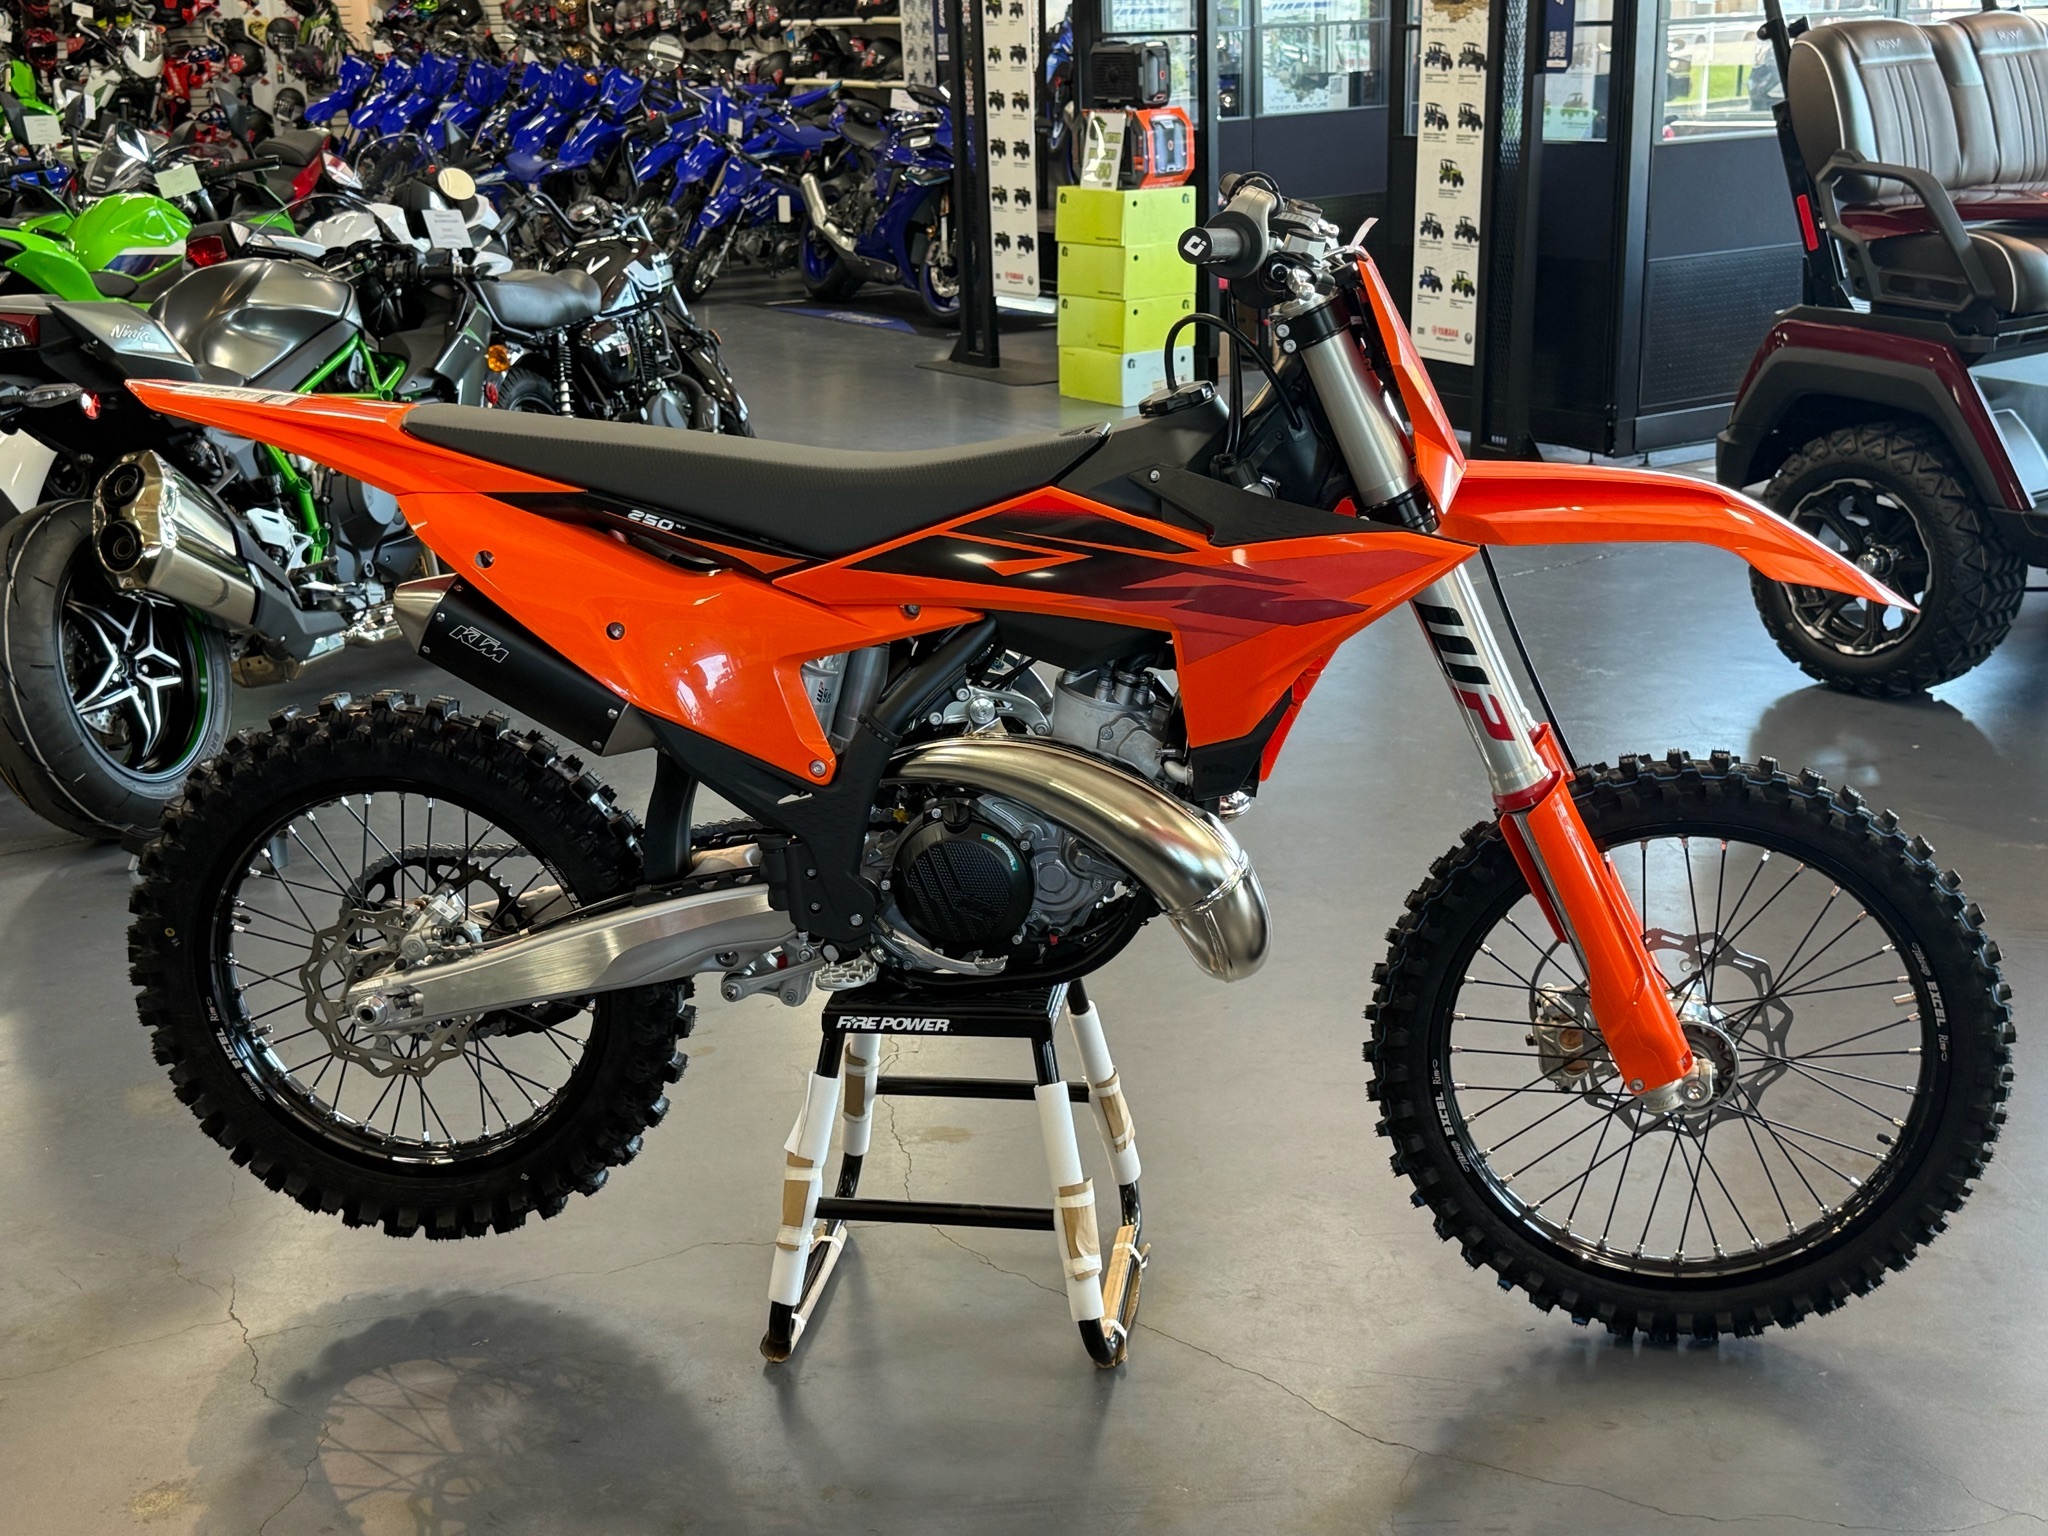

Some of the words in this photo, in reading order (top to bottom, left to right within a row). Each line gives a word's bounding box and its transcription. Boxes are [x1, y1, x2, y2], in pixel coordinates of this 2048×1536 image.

[110, 324, 150, 343] Ninja
[627, 509, 675, 531] 250
[449, 625, 510, 663] KTM
[1926, 981, 1946, 1027] EXCEL
[836, 1016, 881, 1029] FIRE
[879, 1017, 950, 1032] POWER
[216, 1027, 244, 1069] EXCEL
[1435, 1092, 1455, 1136] EXCEL
